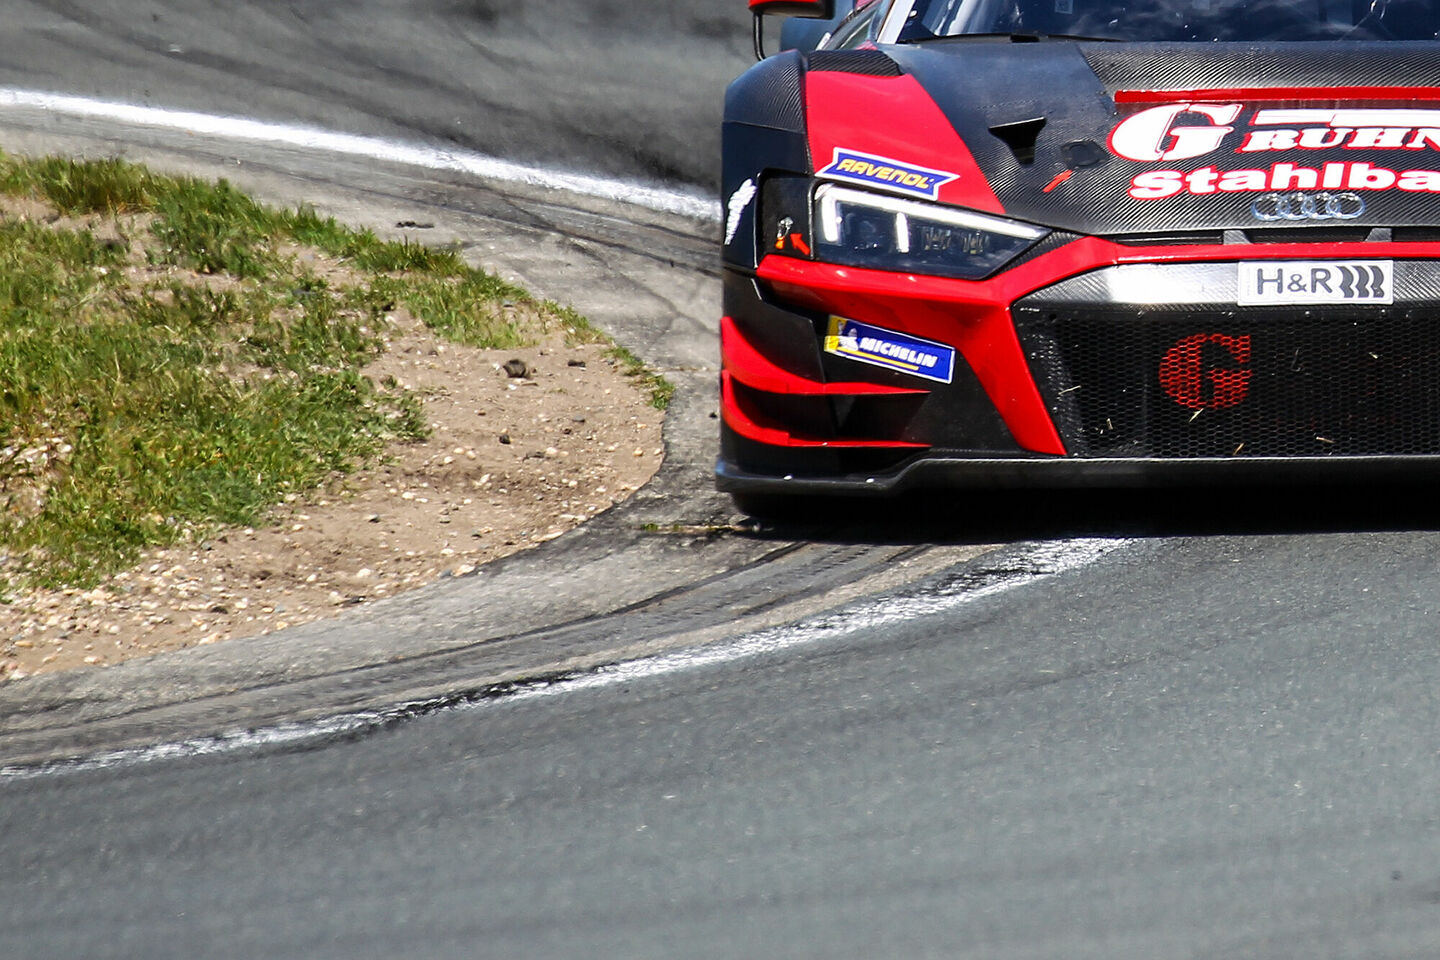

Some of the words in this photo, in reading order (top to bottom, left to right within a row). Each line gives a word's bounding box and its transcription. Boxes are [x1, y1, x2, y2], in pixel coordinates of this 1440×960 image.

[835, 158, 934, 190] RAVENOL
[1256, 267, 1333, 295] H&R
[858, 336, 939, 369] MICHELIN
